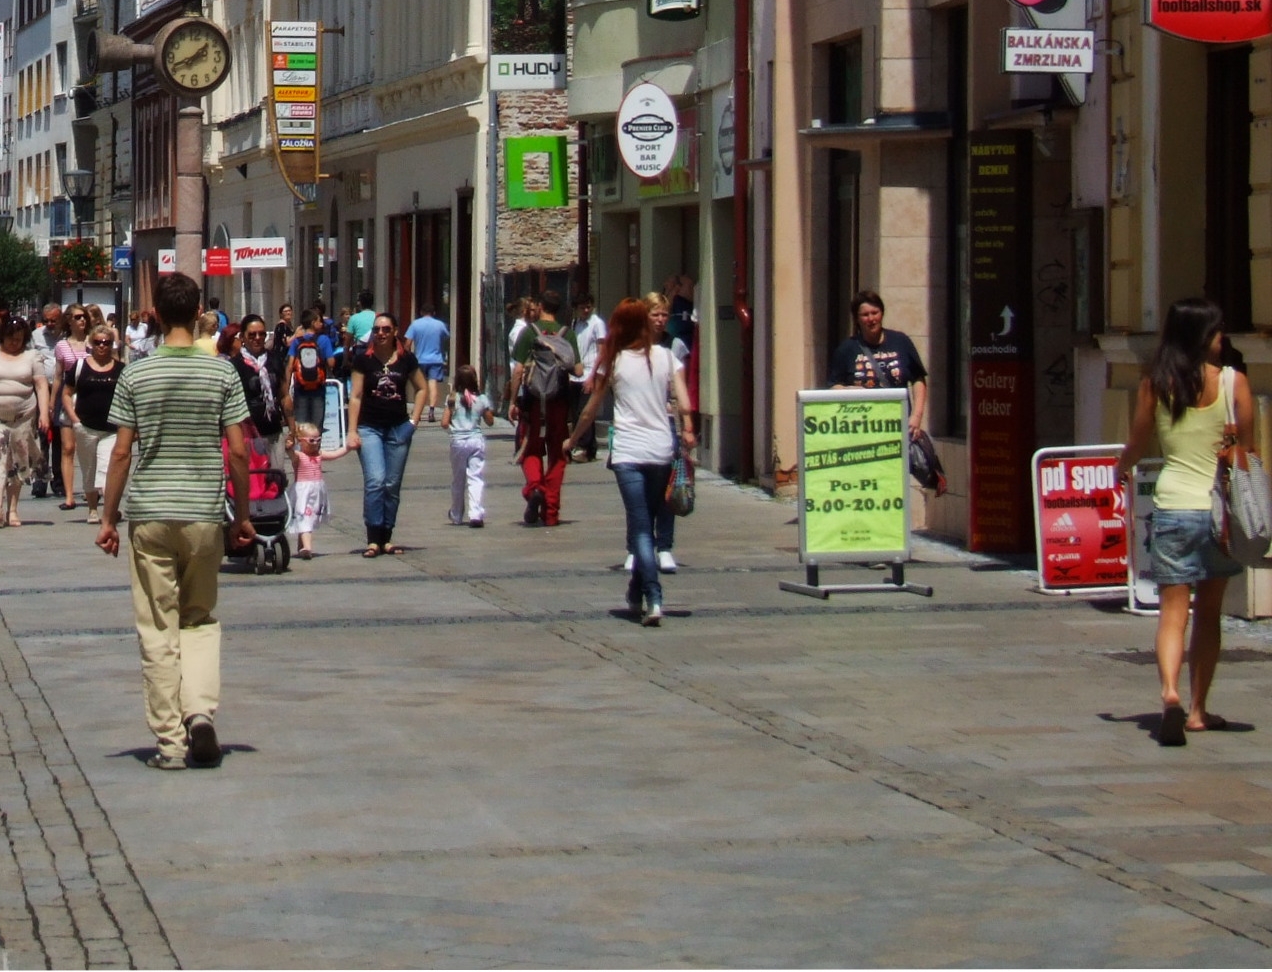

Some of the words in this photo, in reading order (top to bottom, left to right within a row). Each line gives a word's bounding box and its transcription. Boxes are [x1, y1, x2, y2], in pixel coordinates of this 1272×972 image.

[1008, 33, 1091, 49] BALKÁNSKA
[1014, 53, 1082, 67] ZMRZLINA
[514, 62, 561, 75] HUDY
[635, 144, 661, 152] SPORT
[234, 247, 283, 261] TURANCAR
[974, 369, 1016, 393] Galery
[978, 399, 1012, 416] dekor
[804, 415, 901, 435] Solárium
[830, 479, 878, 492] Po-Pi
[1041, 462, 1066, 496] pd
[1071, 465, 1115, 495] spor
[805, 497, 903, 513] 8.00-20.00
